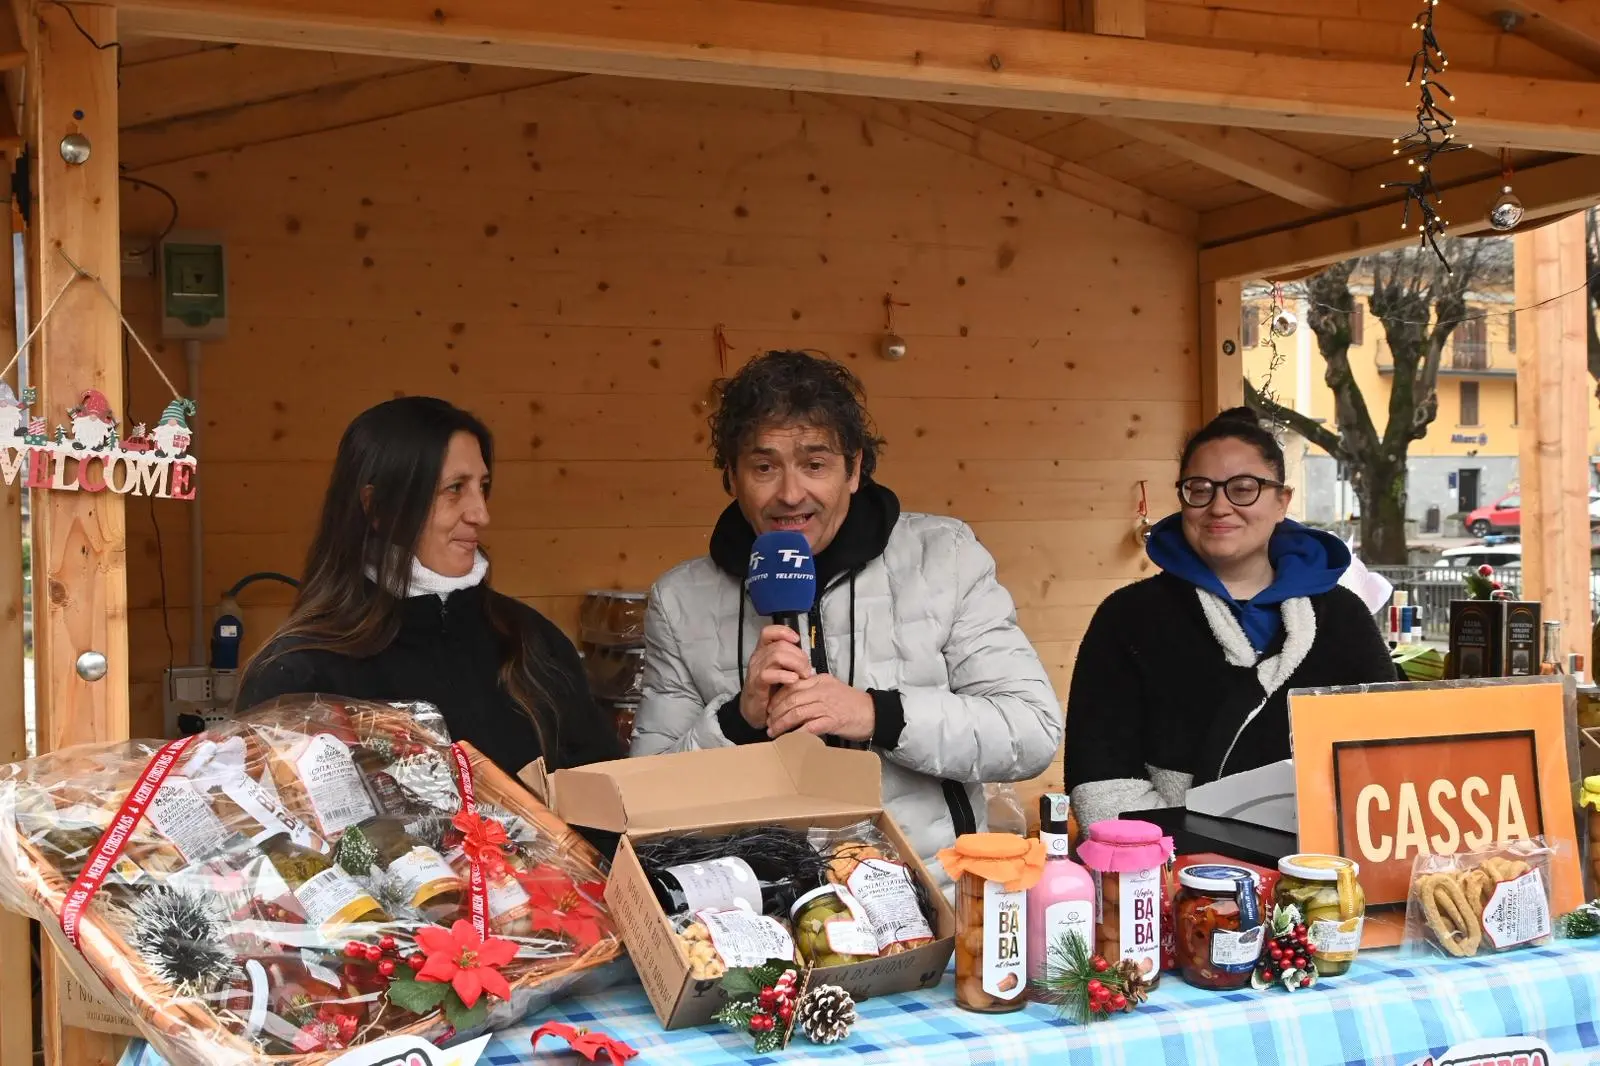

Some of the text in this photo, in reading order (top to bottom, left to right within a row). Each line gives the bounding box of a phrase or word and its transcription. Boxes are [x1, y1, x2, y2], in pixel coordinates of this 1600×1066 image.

[135, 778, 153, 805] MERRY
[148, 752, 174, 783] CHRISTMAS
[1355, 774, 1531, 863] CASSA
[88, 815, 135, 880] MERRY CHRISTMAS
[999, 911, 1019, 934] BA
[1134, 897, 1154, 921] BA
